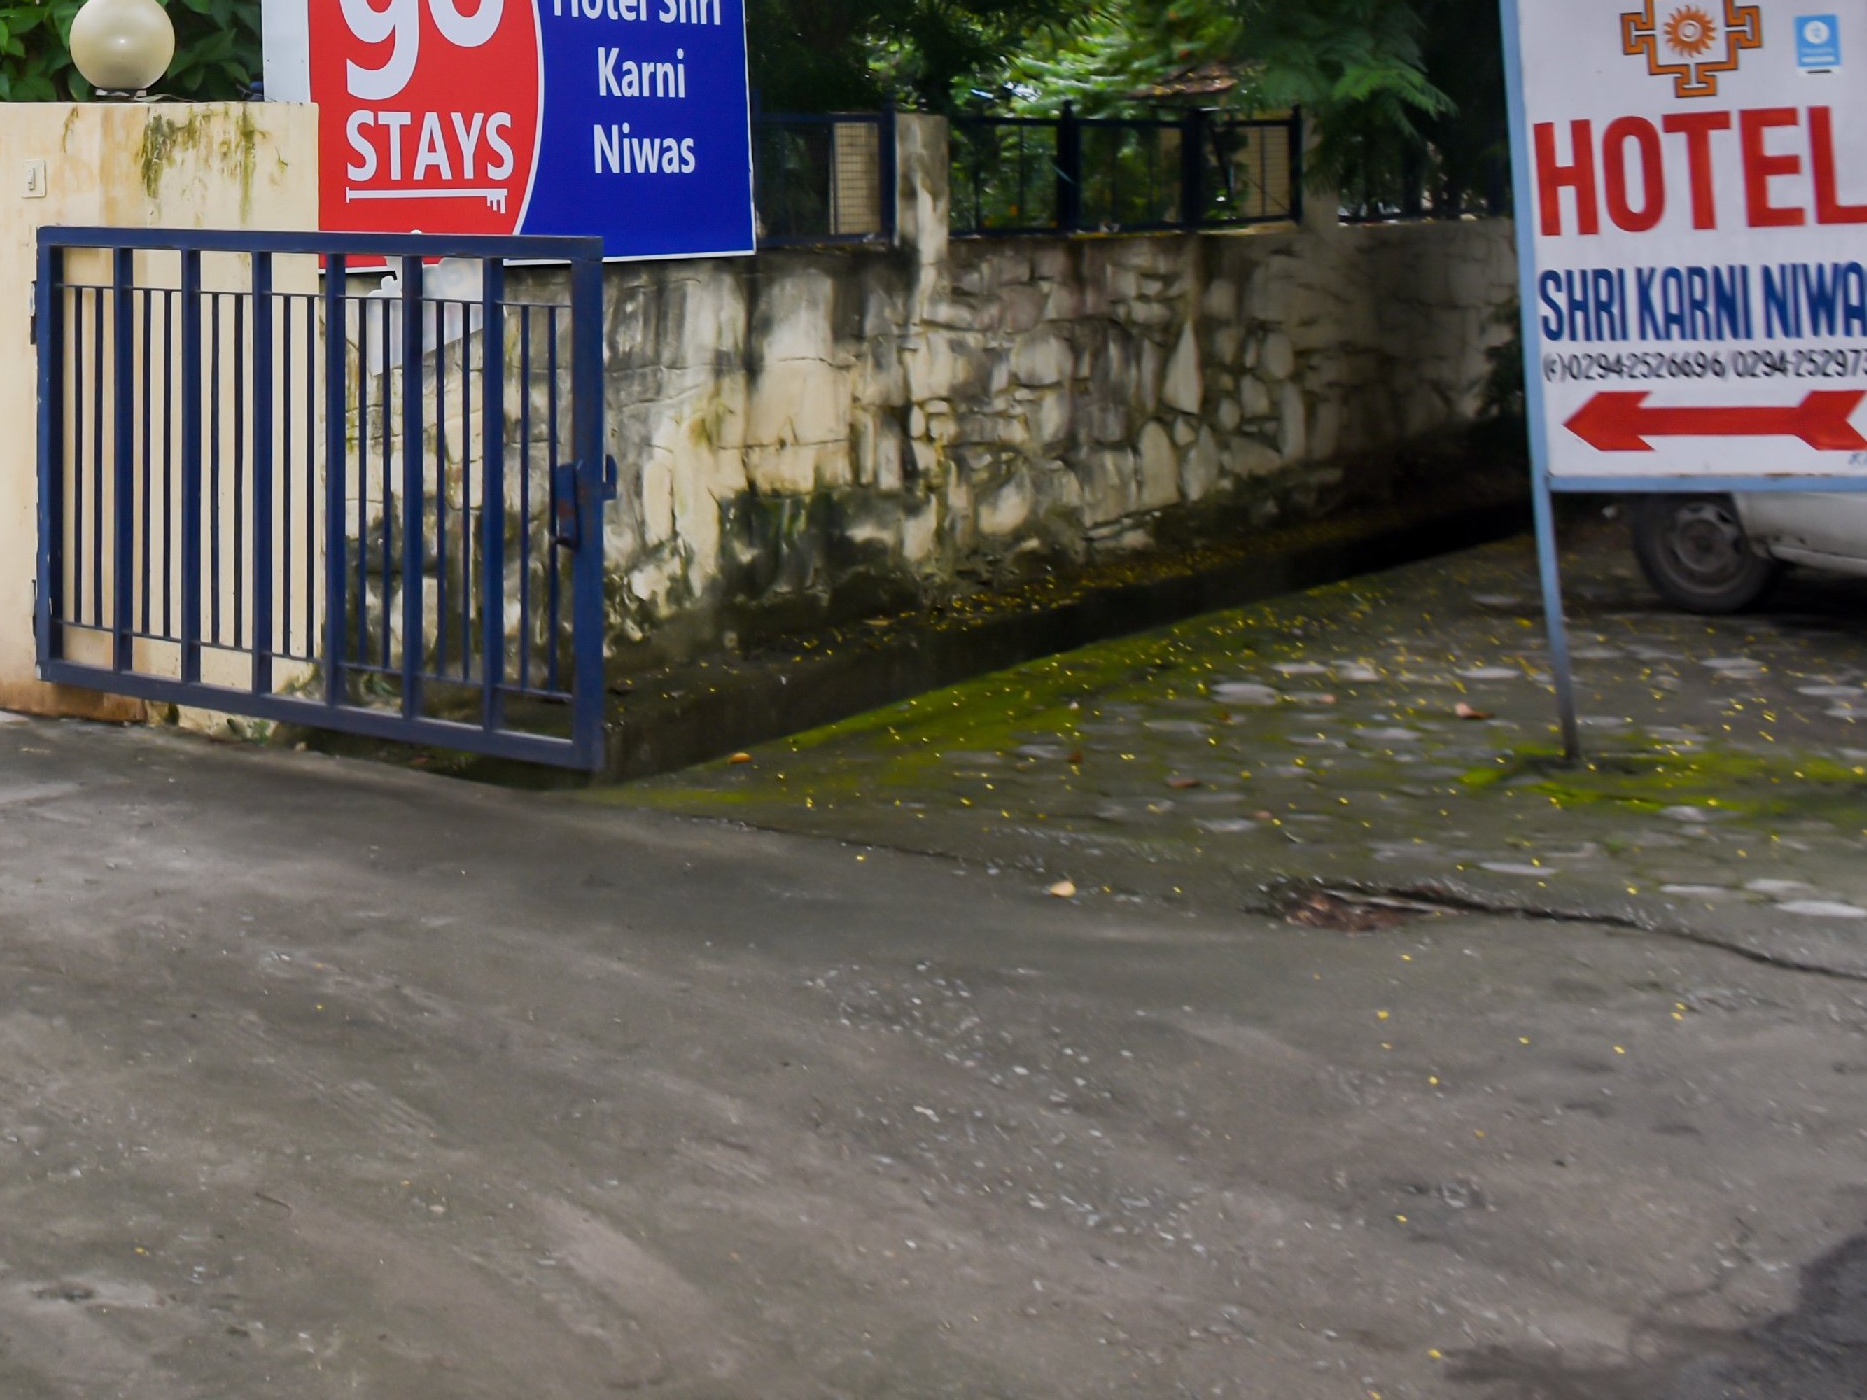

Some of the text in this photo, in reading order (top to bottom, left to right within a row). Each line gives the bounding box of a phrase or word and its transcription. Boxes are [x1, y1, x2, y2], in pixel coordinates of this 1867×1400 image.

[598, 47, 686, 98] Karni
[346, 110, 514, 181] STAYS
[593, 123, 696, 174] Niwas
[1534, 106, 1867, 236] HOTEL
[1539, 267, 1629, 341] SHRI
[1636, 264, 1753, 341] KARNI
